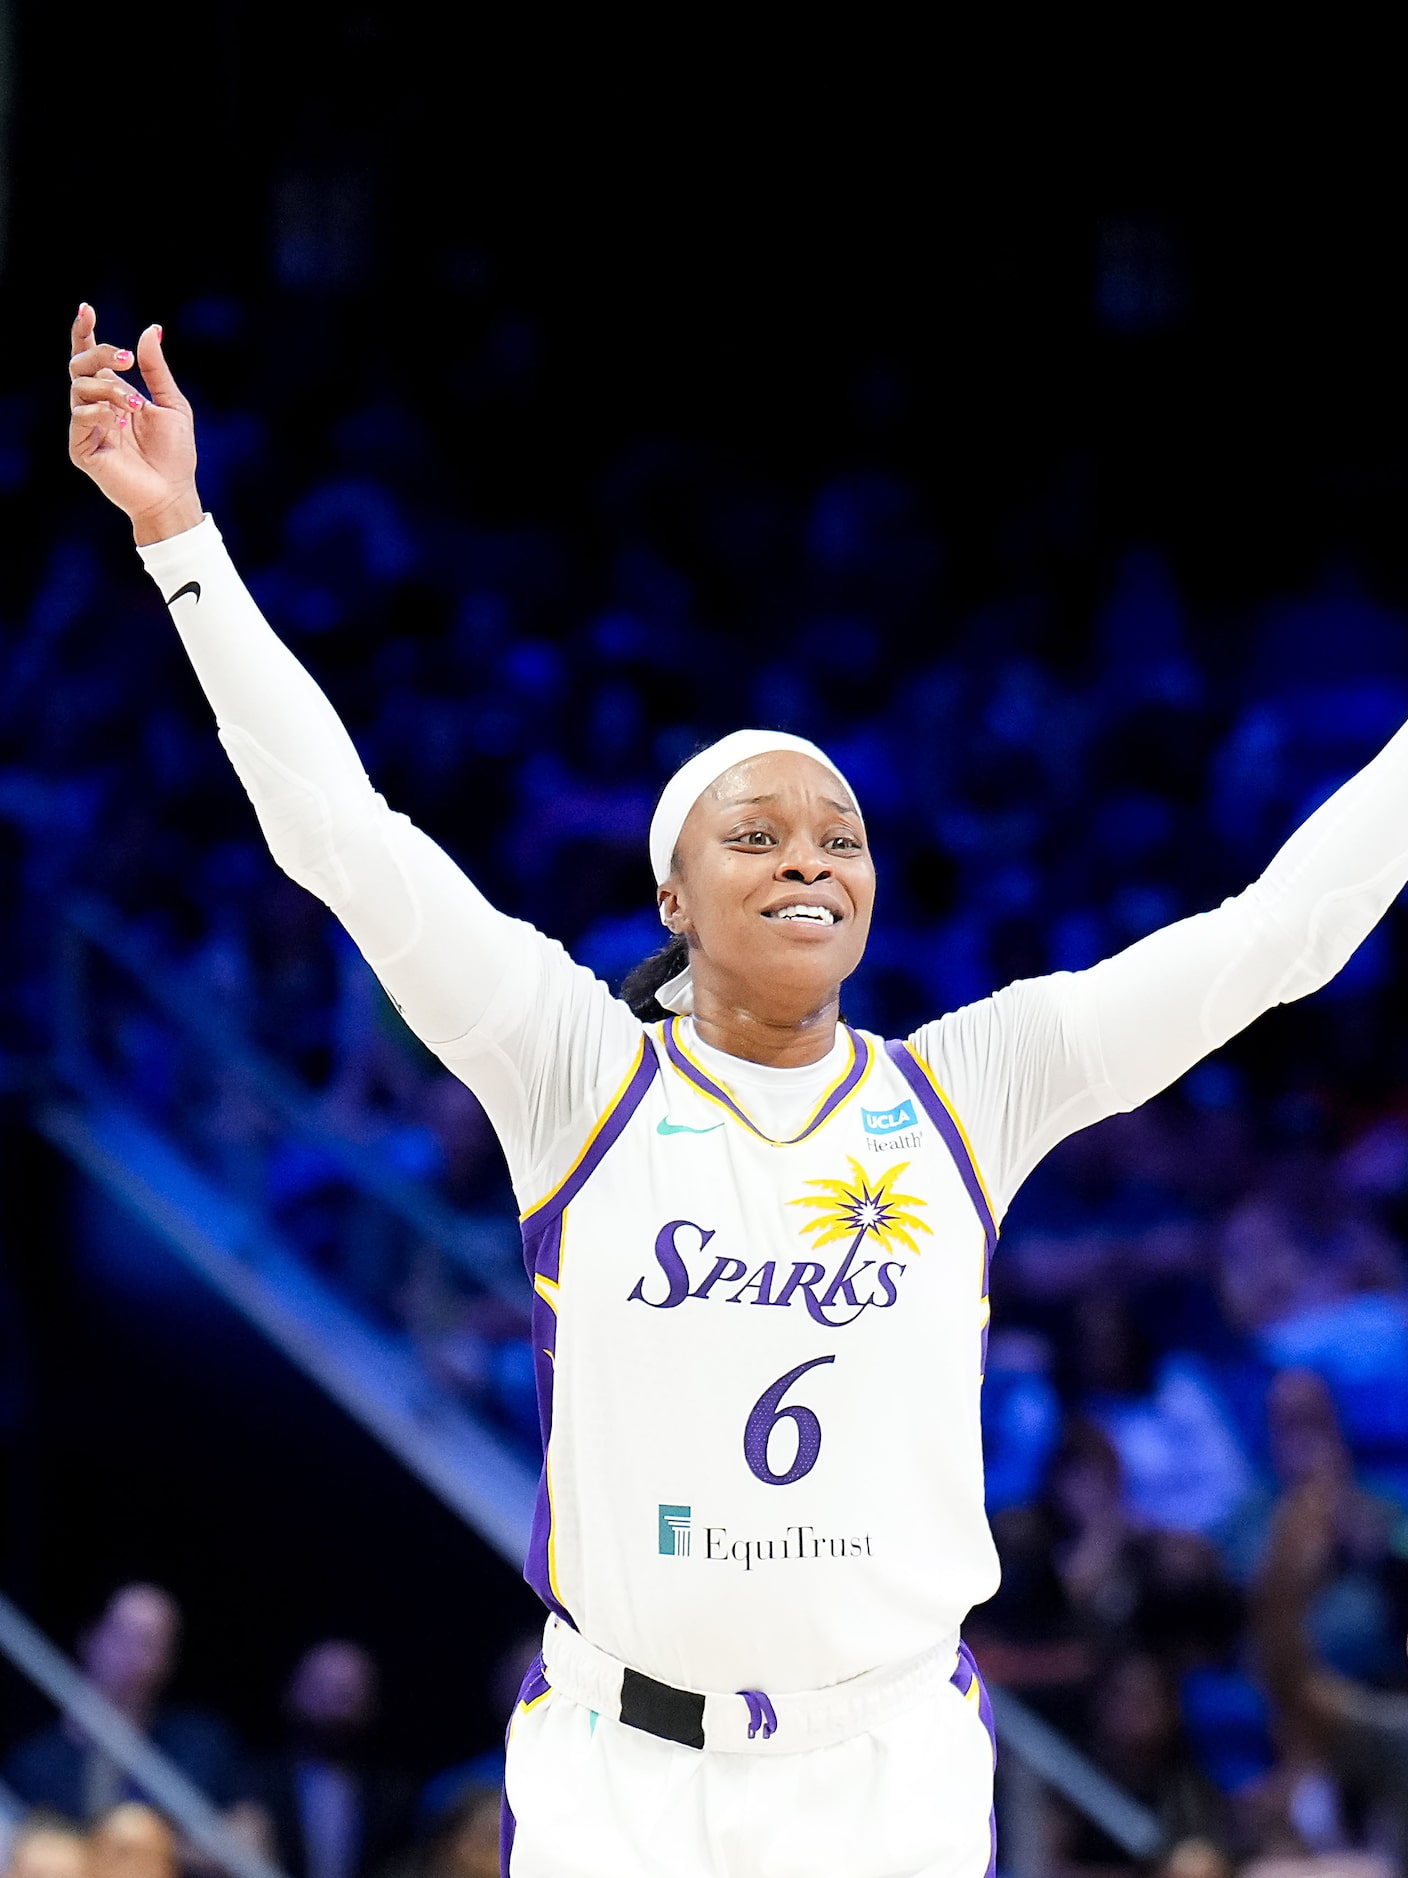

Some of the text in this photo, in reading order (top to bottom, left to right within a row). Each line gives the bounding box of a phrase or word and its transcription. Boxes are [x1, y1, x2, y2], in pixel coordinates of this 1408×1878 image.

[866, 1110, 911, 1129] UCLA
[866, 1132, 922, 1153] Health
[743, 1355, 836, 1486] 6
[704, 1526, 875, 1571] EquiTrust
